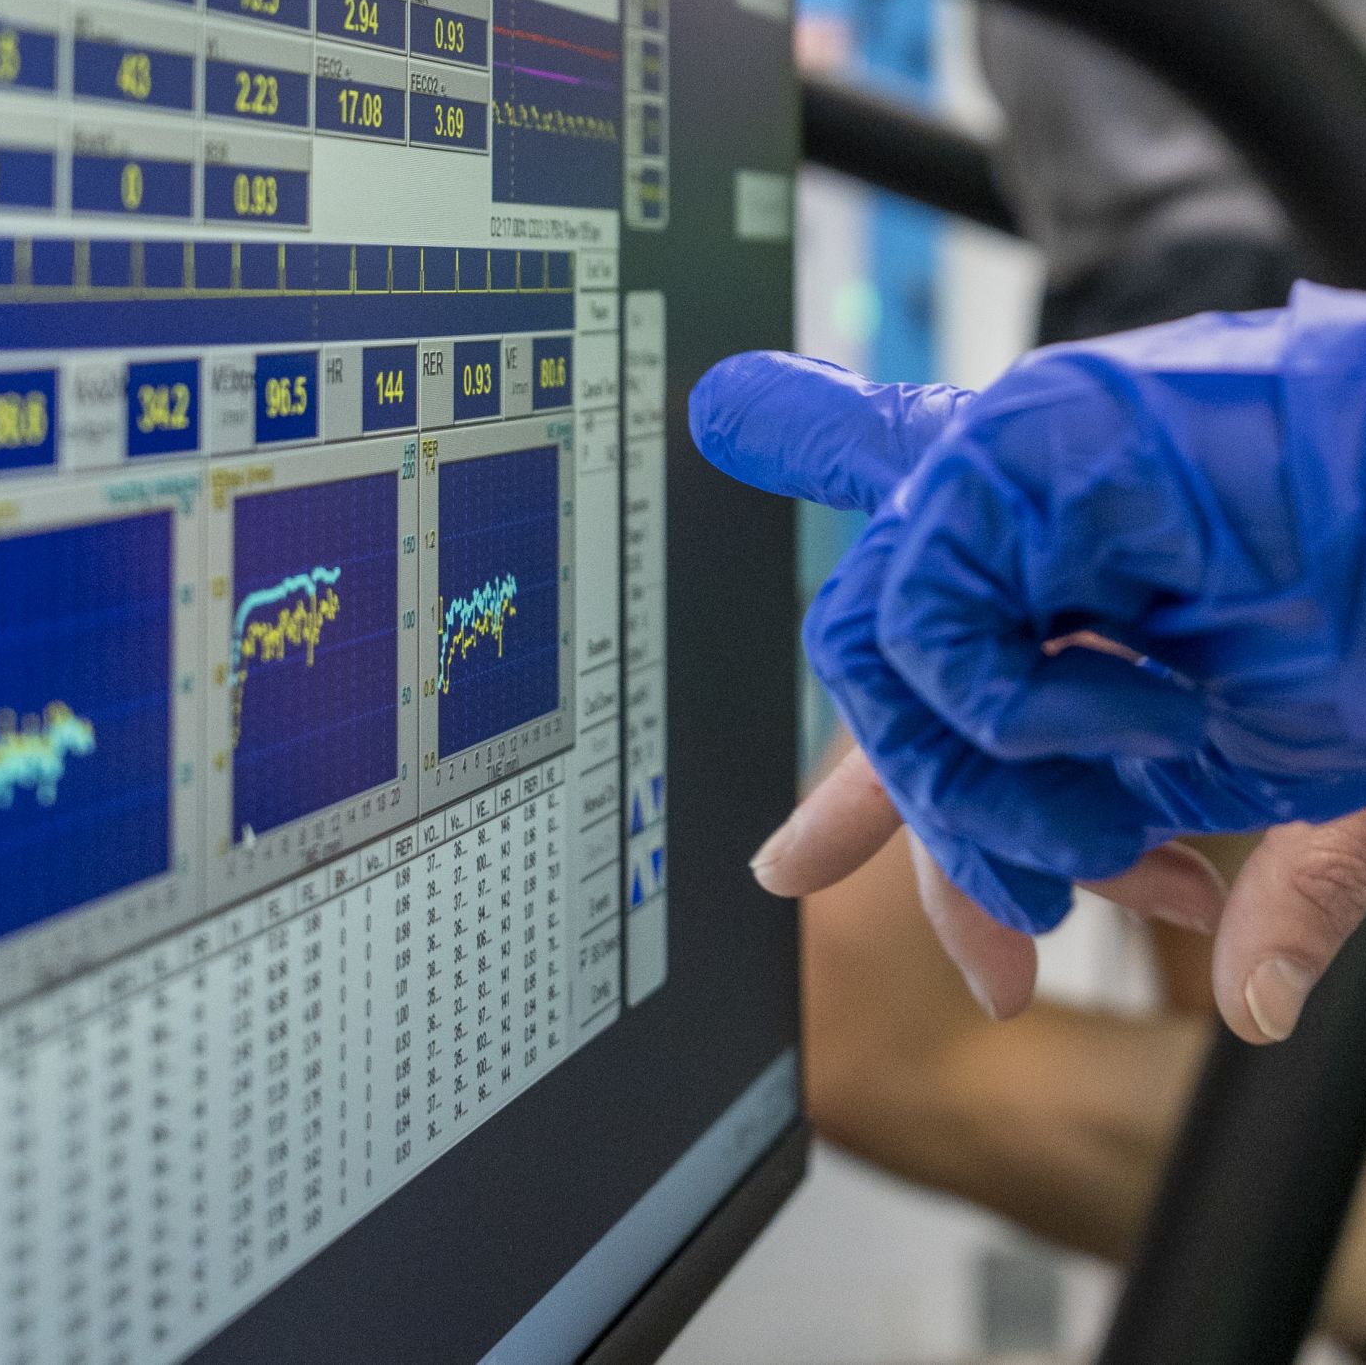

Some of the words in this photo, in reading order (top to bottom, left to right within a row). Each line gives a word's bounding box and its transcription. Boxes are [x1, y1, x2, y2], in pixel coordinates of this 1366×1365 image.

[434, 16, 465, 54] 0.93
[116, 52, 152, 101] 43
[236, 71, 279, 115] 2.23
[338, 88, 383, 128] 17.08
[434, 104, 465, 139] 3.69
[233, 173, 278, 216] 0.93
[325, 356, 344, 385] HR
[422, 350, 444, 377] RER
[504, 345, 518, 370] VE
[539, 355, 567, 389] 80.6
[264, 375, 308, 420] 96.5
[375, 369, 404, 406] 144
[463, 362, 492, 397] 0.93
[403, 440, 416, 460] HR
[421, 438, 439, 458] RER
[424, 458, 436, 476] 1.4
[402, 460, 415, 481] 200
[402, 534, 416, 555] 150
[424, 529, 436, 550] 1.2
[402, 609, 416, 629] 100
[423, 677, 435, 698] 0.8
[401, 762, 408, 781] 0
[435, 767, 442, 786] 0
[448, 762, 455, 781] 2
[462, 756, 468, 775] 4
[497, 739, 506, 758] 10
[509, 734, 518, 753] 12
[395, 834, 413, 857] RER
[500, 787, 512, 808] HR
[395, 865, 410, 890] 0.98
[500, 814, 510, 835] 146
[395, 892, 410, 918] 0.96
[500, 839, 510, 860] 143
[395, 920, 410, 945] 0.98
[500, 864, 510, 885] 142
[395, 947, 410, 973] 0.99
[500, 889, 510, 910] 142
[500, 914, 510, 936] 143
[395, 1002, 409, 1029] 1.00
[500, 939, 510, 961] 143
[395, 1029, 410, 1056] 0.93
[500, 964, 510, 986] 141
[395, 1056, 410, 1084] 0.95
[500, 989, 510, 1011] 141
[395, 1084, 410, 1112] 0.94
[500, 1013, 510, 1036] 142
[395, 1111, 410, 1139] 0.94
[500, 1038, 510, 1062] 144
[395, 1138, 410, 1167] 0.93
[500, 1063, 510, 1087] 144
